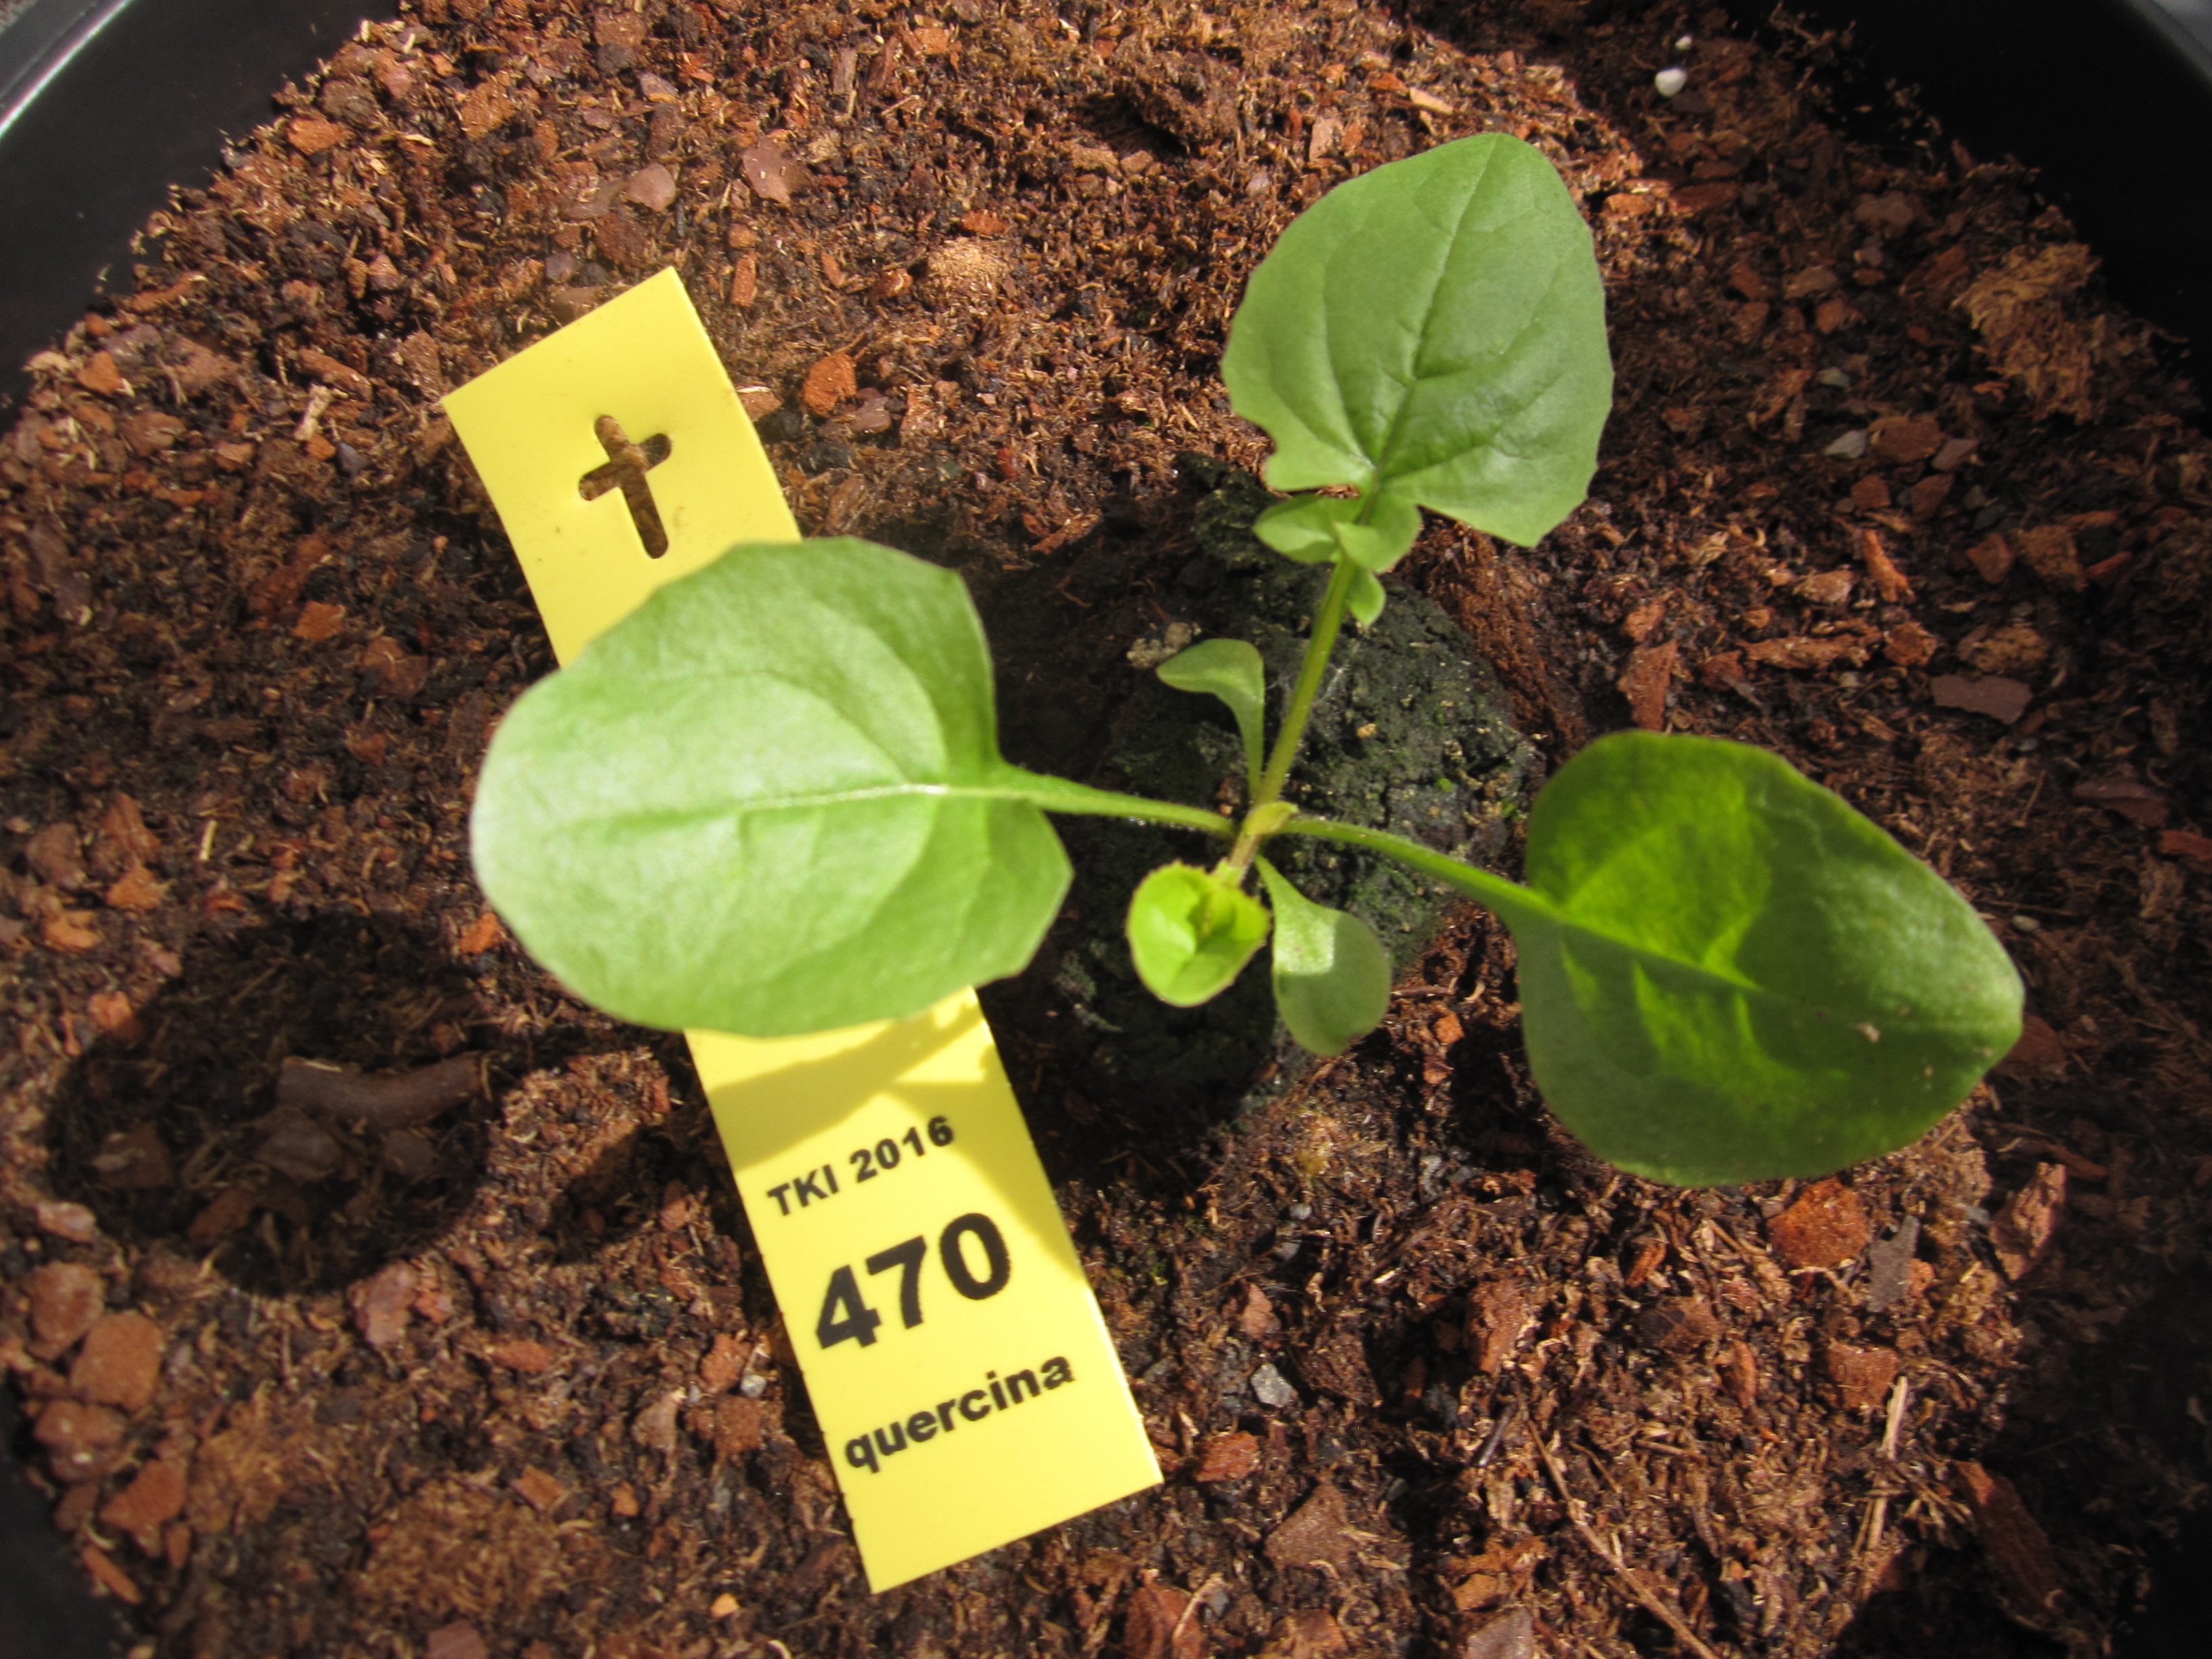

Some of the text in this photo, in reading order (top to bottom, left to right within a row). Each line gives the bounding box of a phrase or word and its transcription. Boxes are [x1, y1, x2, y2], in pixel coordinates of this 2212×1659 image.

[767, 1115, 954, 1216] TKI 2016
[815, 1212, 1010, 1349] 470
[845, 1356, 1077, 1473] quercina
